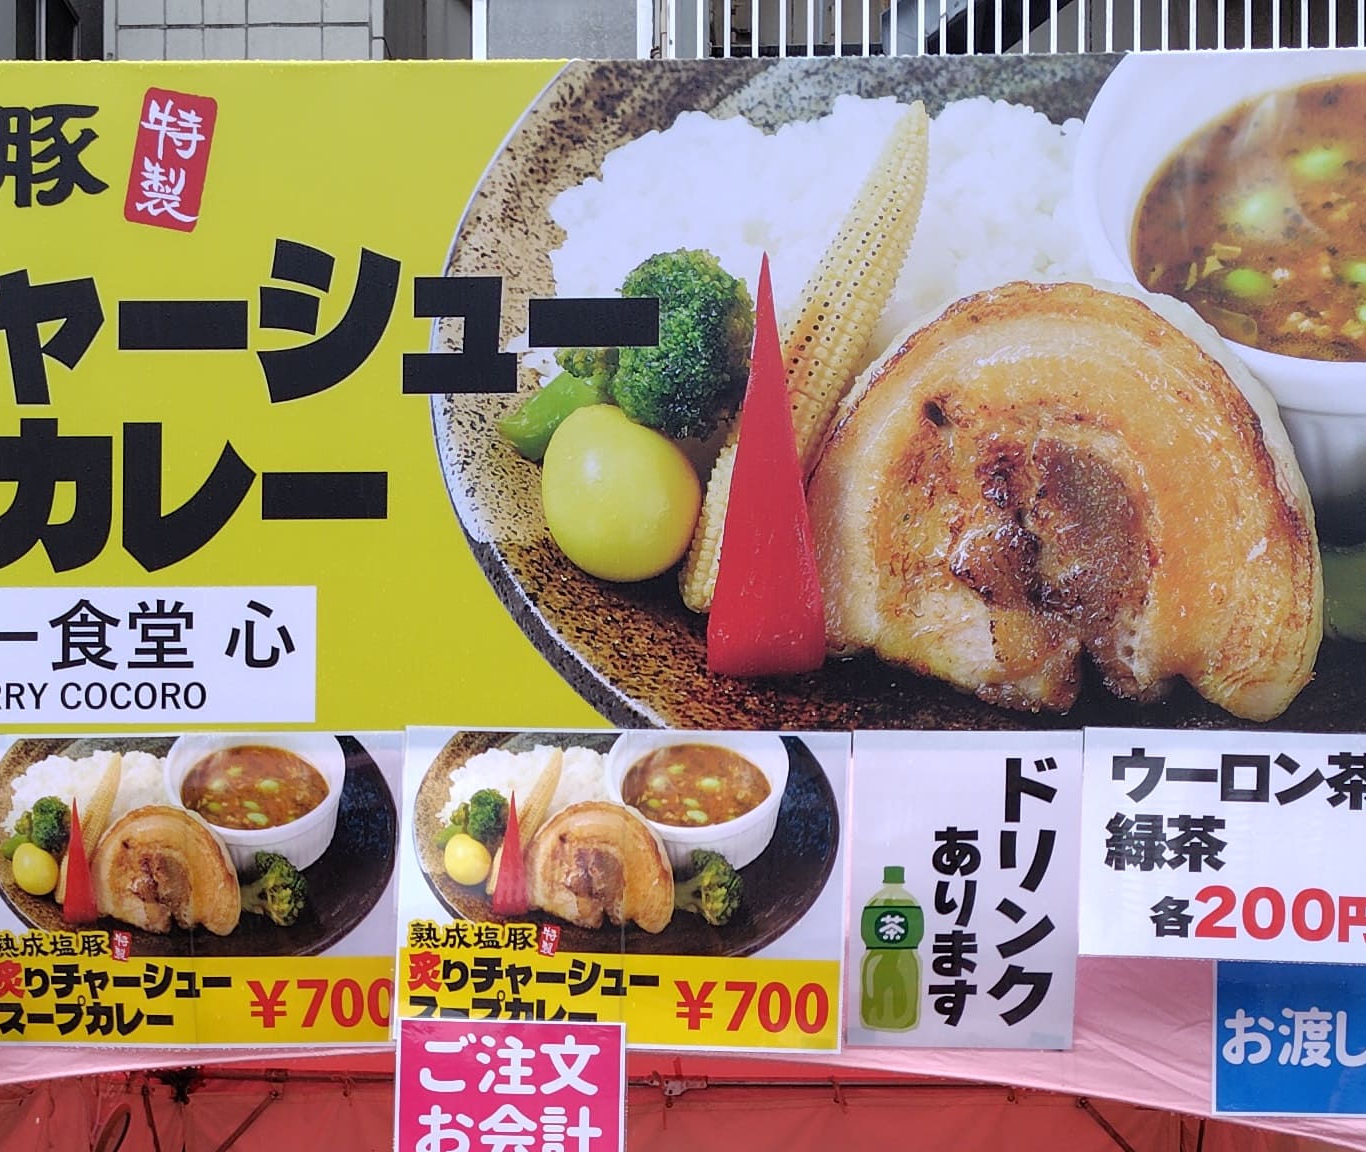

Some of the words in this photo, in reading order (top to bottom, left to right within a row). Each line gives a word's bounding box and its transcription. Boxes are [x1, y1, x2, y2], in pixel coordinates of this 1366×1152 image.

[135, 99, 205, 221] 特製
[224, 601, 295, 670] 心
[60, 682, 207, 711] COCORO
[1105, 812, 1227, 872] 緑茶
[988, 757, 1057, 1026] ドリンク
[410, 922, 535, 951] 熟成塩豚
[929, 826, 981, 1026] あります
[407, 951, 659, 996] 炙りチャーシュー
[419, 1033, 601, 1096] ご注文
